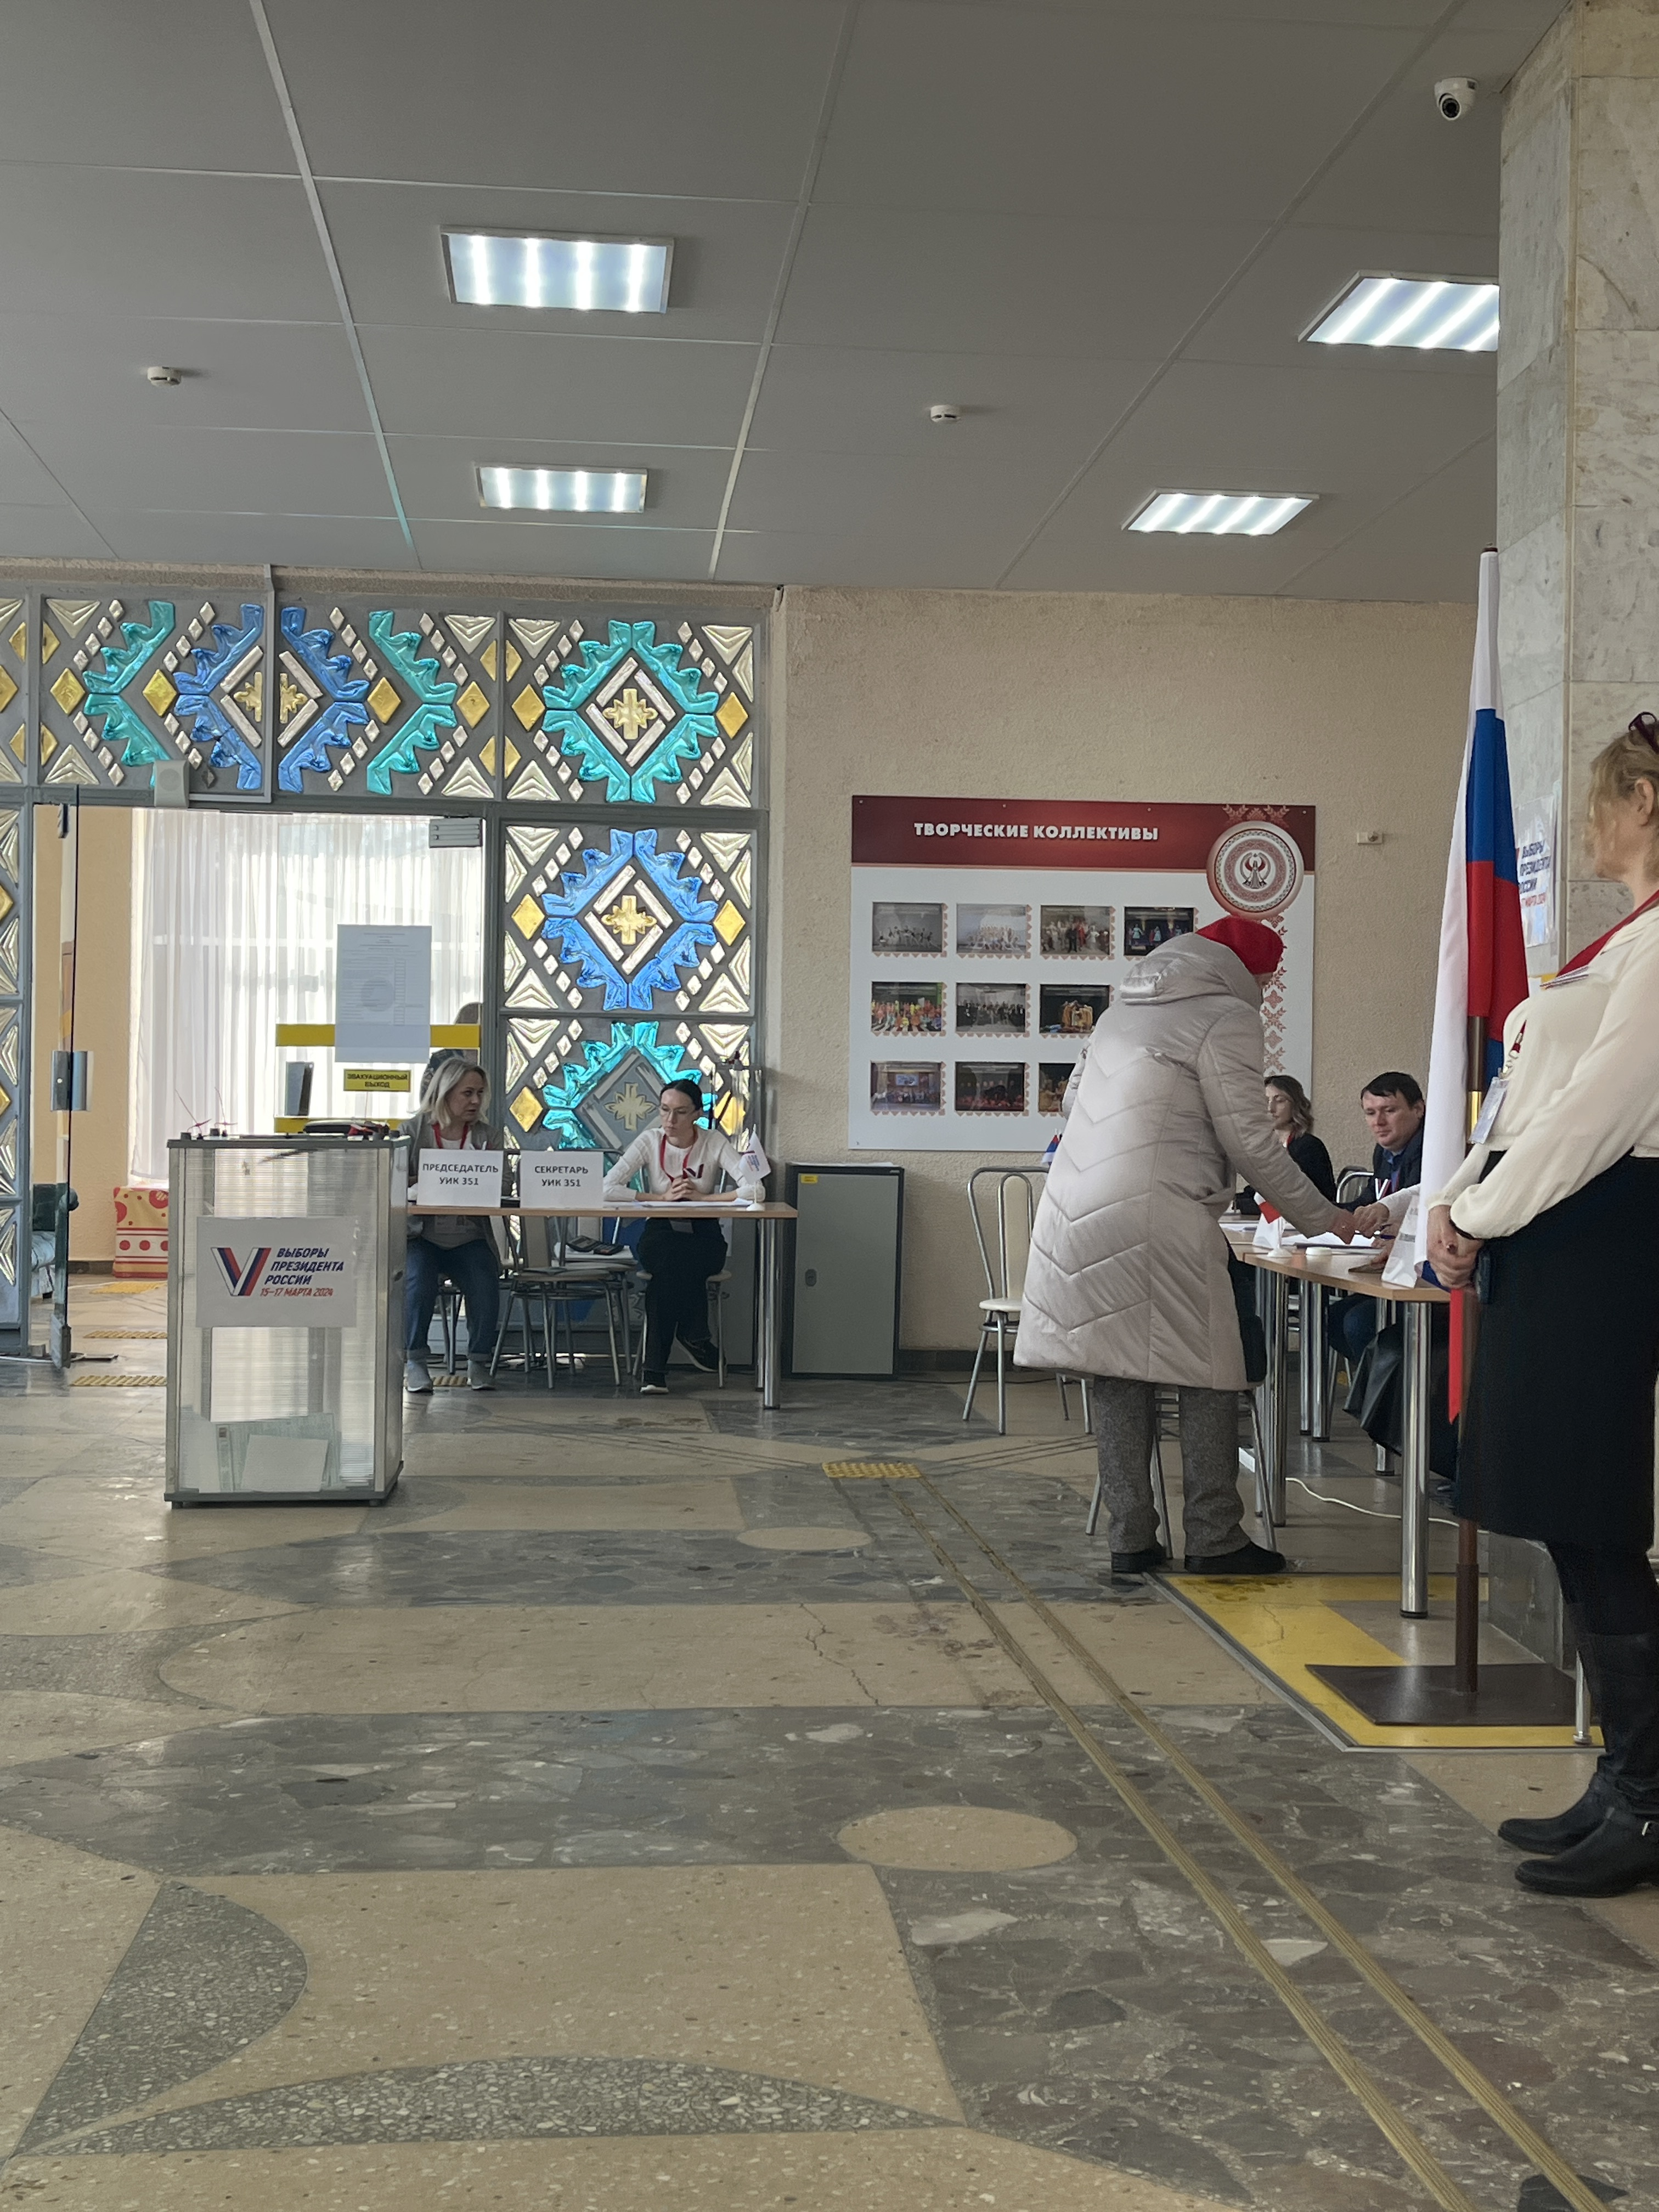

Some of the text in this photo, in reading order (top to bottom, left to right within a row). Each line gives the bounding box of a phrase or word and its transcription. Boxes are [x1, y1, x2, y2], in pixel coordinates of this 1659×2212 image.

[914, 822, 1159, 840] ТВОРЧЕСКИЕ КОЛЛЕКТИВЫ
[422, 1164, 499, 1173] ПРЕДСЕДАТЕЛЬ
[563, 1178, 581, 1187] 351
[276, 1248, 330, 1258] ВЫБОРЫ
[270, 1261, 345, 1272] ПРЕЗИДЕНТА
[264, 1274, 312, 1285] РОССИИ
[284, 1288, 312, 1297] МАРТА
[313, 1288, 334, 1297] 2024
